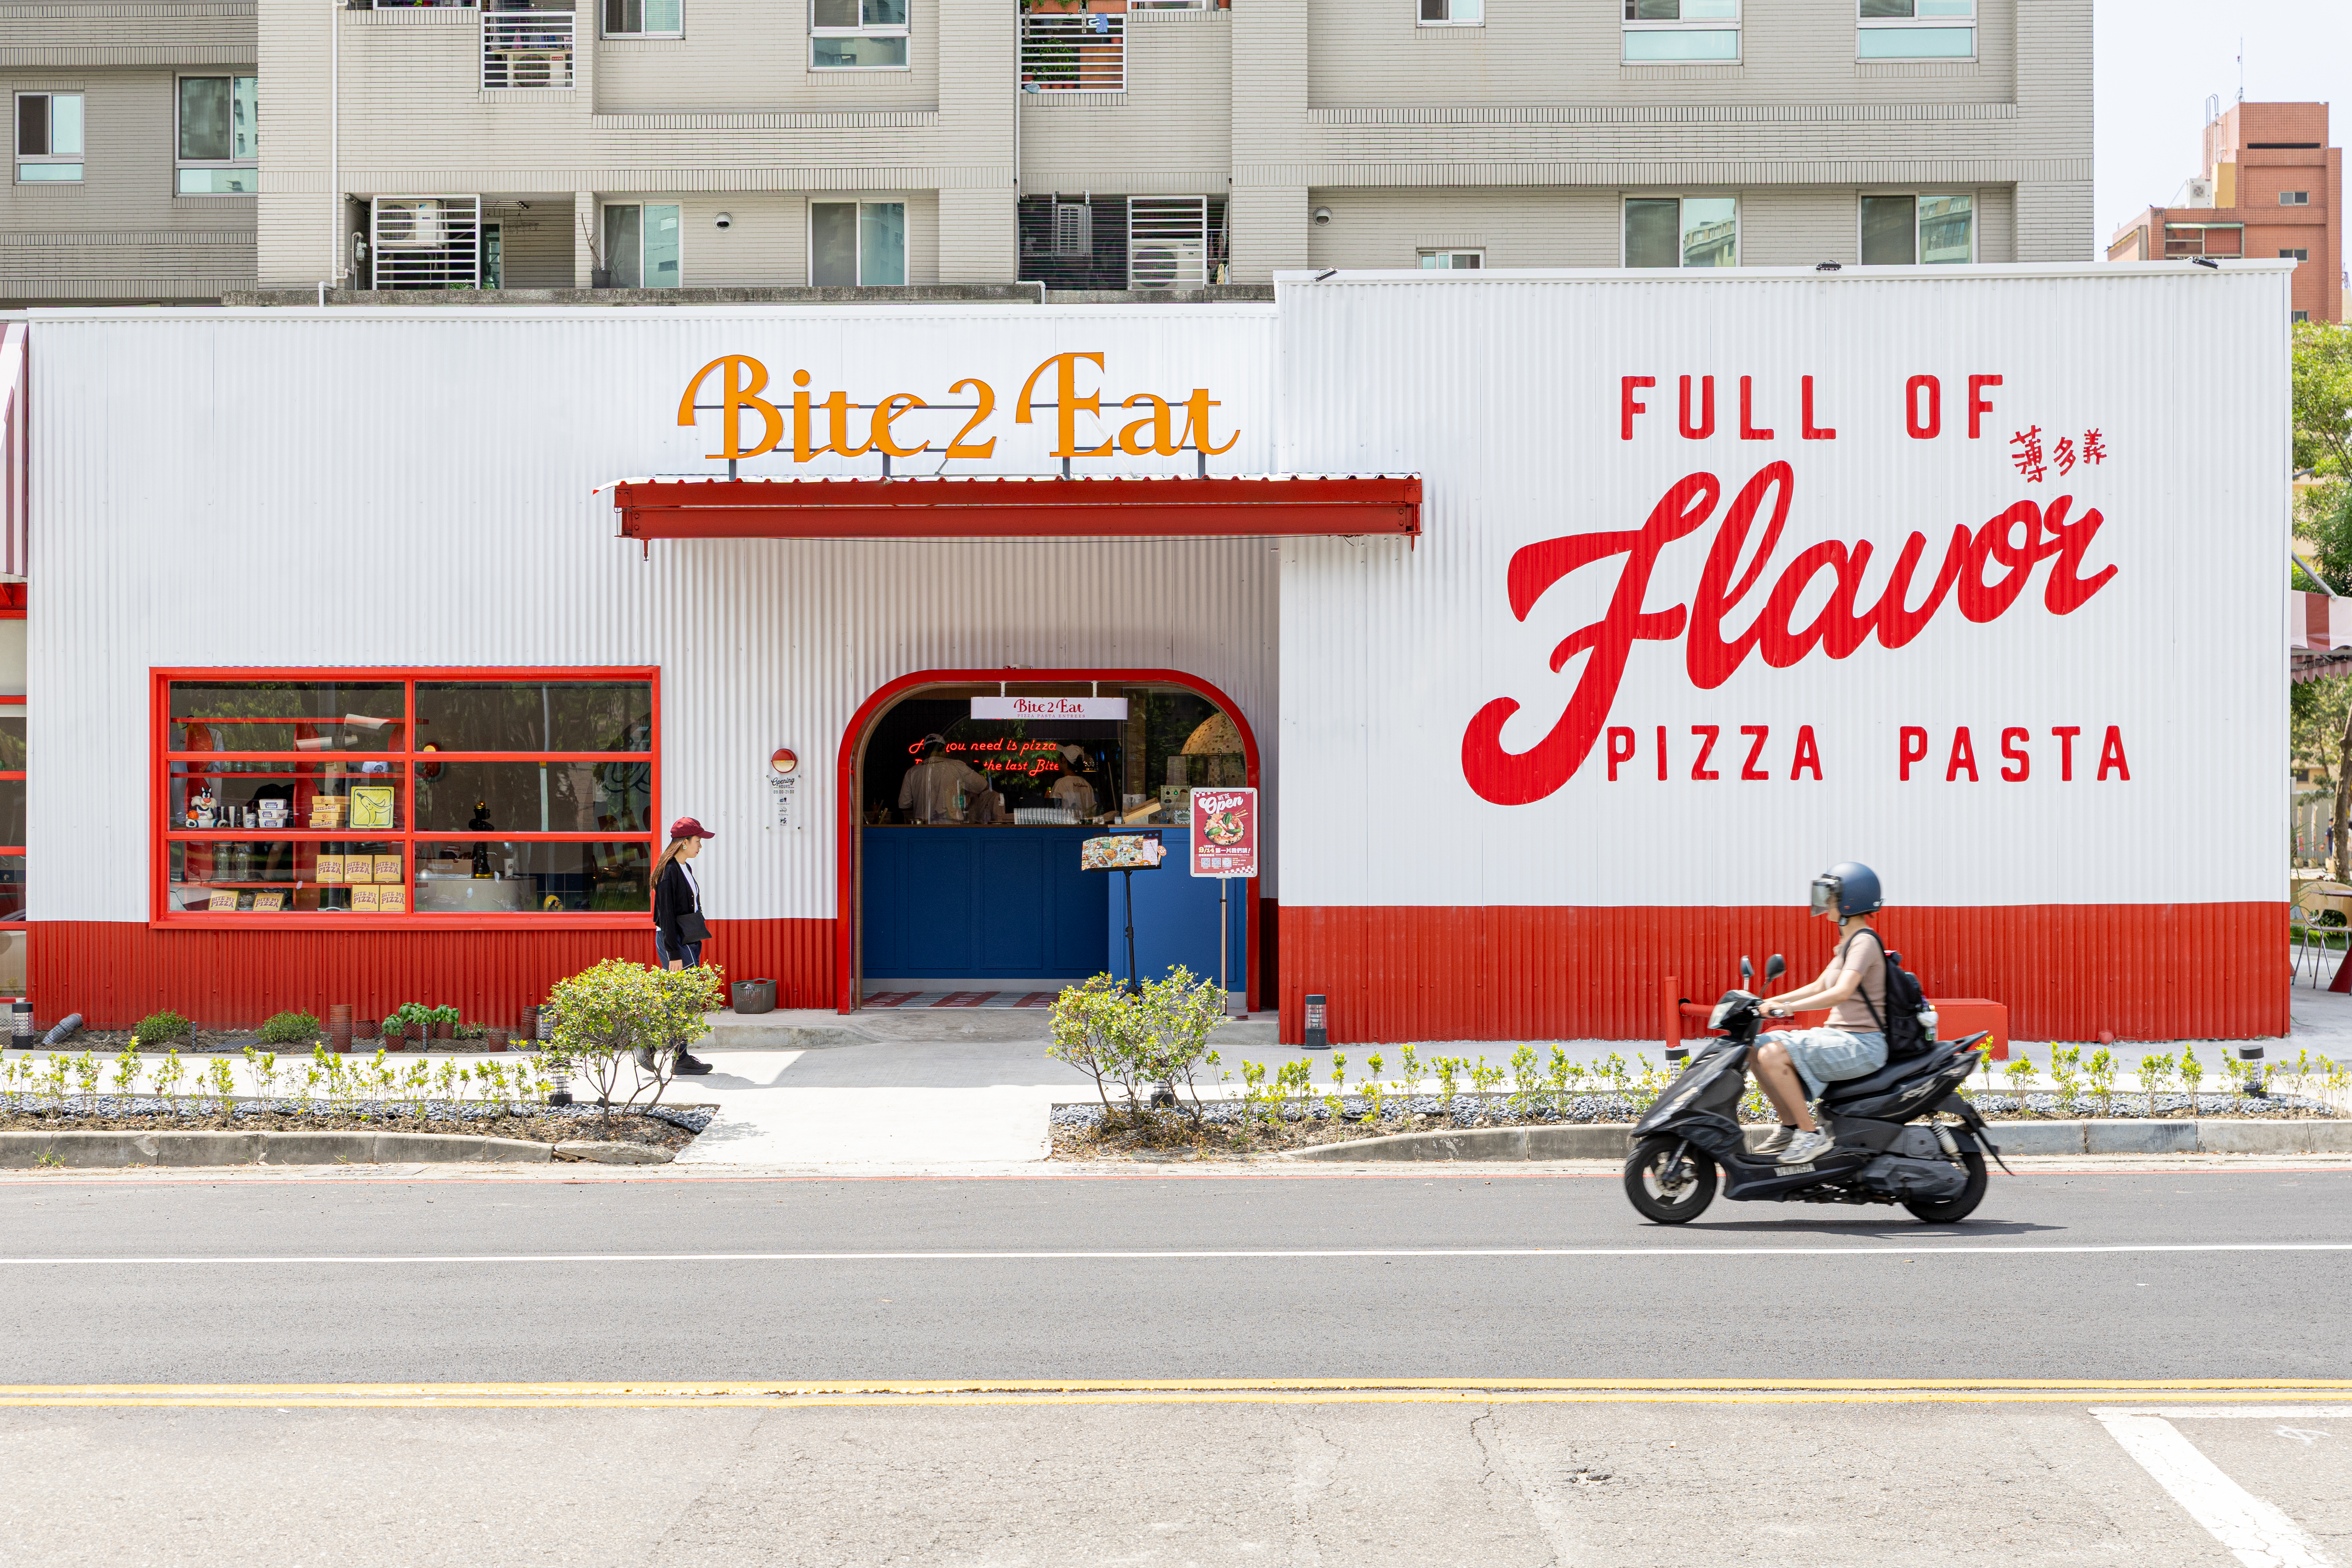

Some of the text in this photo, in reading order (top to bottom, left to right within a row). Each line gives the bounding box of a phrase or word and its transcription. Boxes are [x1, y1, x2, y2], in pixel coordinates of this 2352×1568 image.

[678, 352, 1240, 463] Bite 2 Eat
[1621, 375, 2003, 440] FULL OF
[2010, 425, 2107, 483] 薄多義
[1461, 460, 2118, 805] Flavor
[1013, 699, 1084, 713] Bite 2 Eat
[970, 738, 1004, 751] need
[1007, 739, 1017, 750] is
[1019, 740, 1057, 756] pizza
[1607, 725, 2130, 782] PIZZA PASTA
[983, 759, 1060, 777] the last Bite
[771, 777, 795, 786] Opening
[1198, 796, 1243, 814] Open
[318, 867, 342, 875] PIZZA
[346, 867, 370, 875] PIZZA
[375, 867, 399, 875] PIZZA
[353, 897, 377, 905] PIZZA
[381, 897, 405, 905] PIZZA
